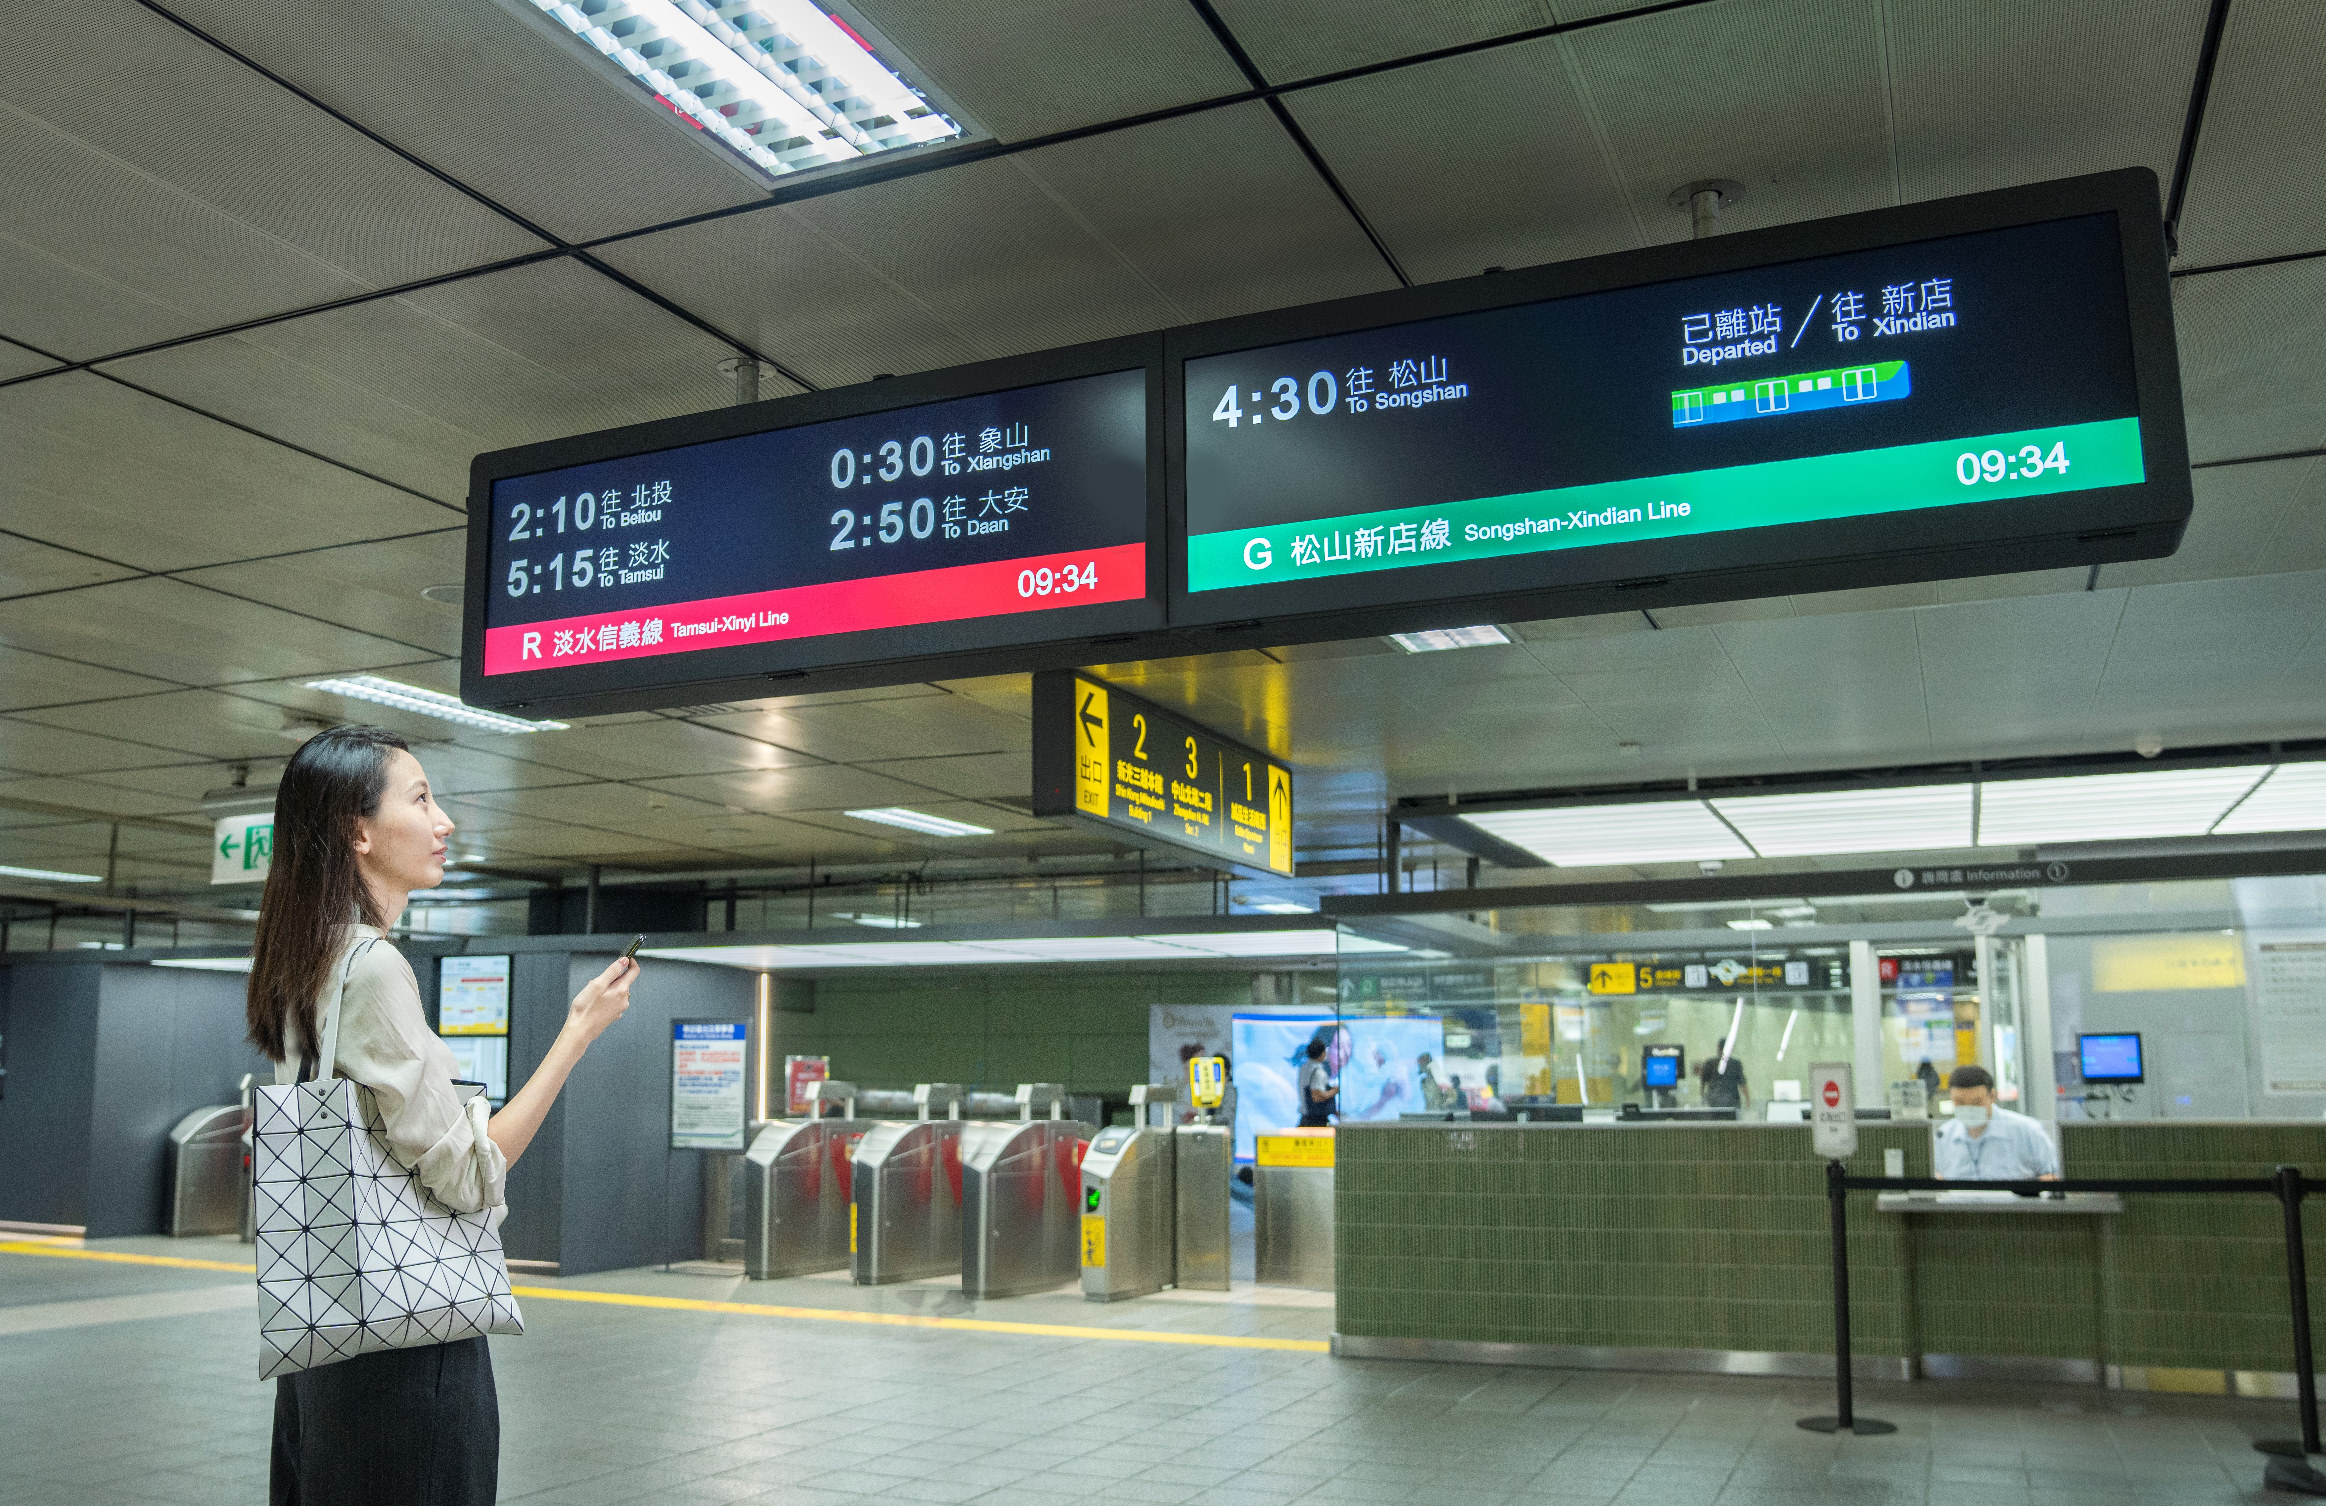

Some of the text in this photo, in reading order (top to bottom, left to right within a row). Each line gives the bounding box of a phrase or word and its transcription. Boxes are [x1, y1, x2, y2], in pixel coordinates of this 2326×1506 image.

[1682, 303, 1781, 344] 已離站
[1831, 290, 1866, 324] 往
[1882, 277, 1953, 315] 新店
[1682, 310, 1955, 366] Departed To Xindian
[1211, 354, 1448, 429] 4:30 往 松山
[1345, 380, 1468, 415] To Songshan
[831, 421, 1029, 489] 0:30 往 象山
[940, 447, 1051, 476] To Xiangshan
[1956, 441, 2070, 486] 09:34
[508, 480, 673, 542] 2:10 往 北投
[600, 508, 661, 529] To Beitou
[830, 486, 1029, 551] 2:50 往 大安
[941, 518, 1009, 539] To Daan
[1243, 499, 1691, 571] G 松山新店線 Songshan-Xindian Line
[507, 538, 670, 598] 5:15 往 淡水
[598, 564, 664, 588] To Tamsui
[1017, 561, 1098, 598] 09:34
[522, 611, 789, 660] R 淡水信義線 Tamsui-Xinyi Line
[1133, 714, 1148, 760] 2
[1185, 736, 1198, 779] 3
[1081, 755, 1102, 784] 出口
[1243, 762, 1252, 801] 1
[1083, 790, 1099, 806] EXIT
[1967, 868, 2041, 882] Information
[1640, 968, 1653, 989] 5
